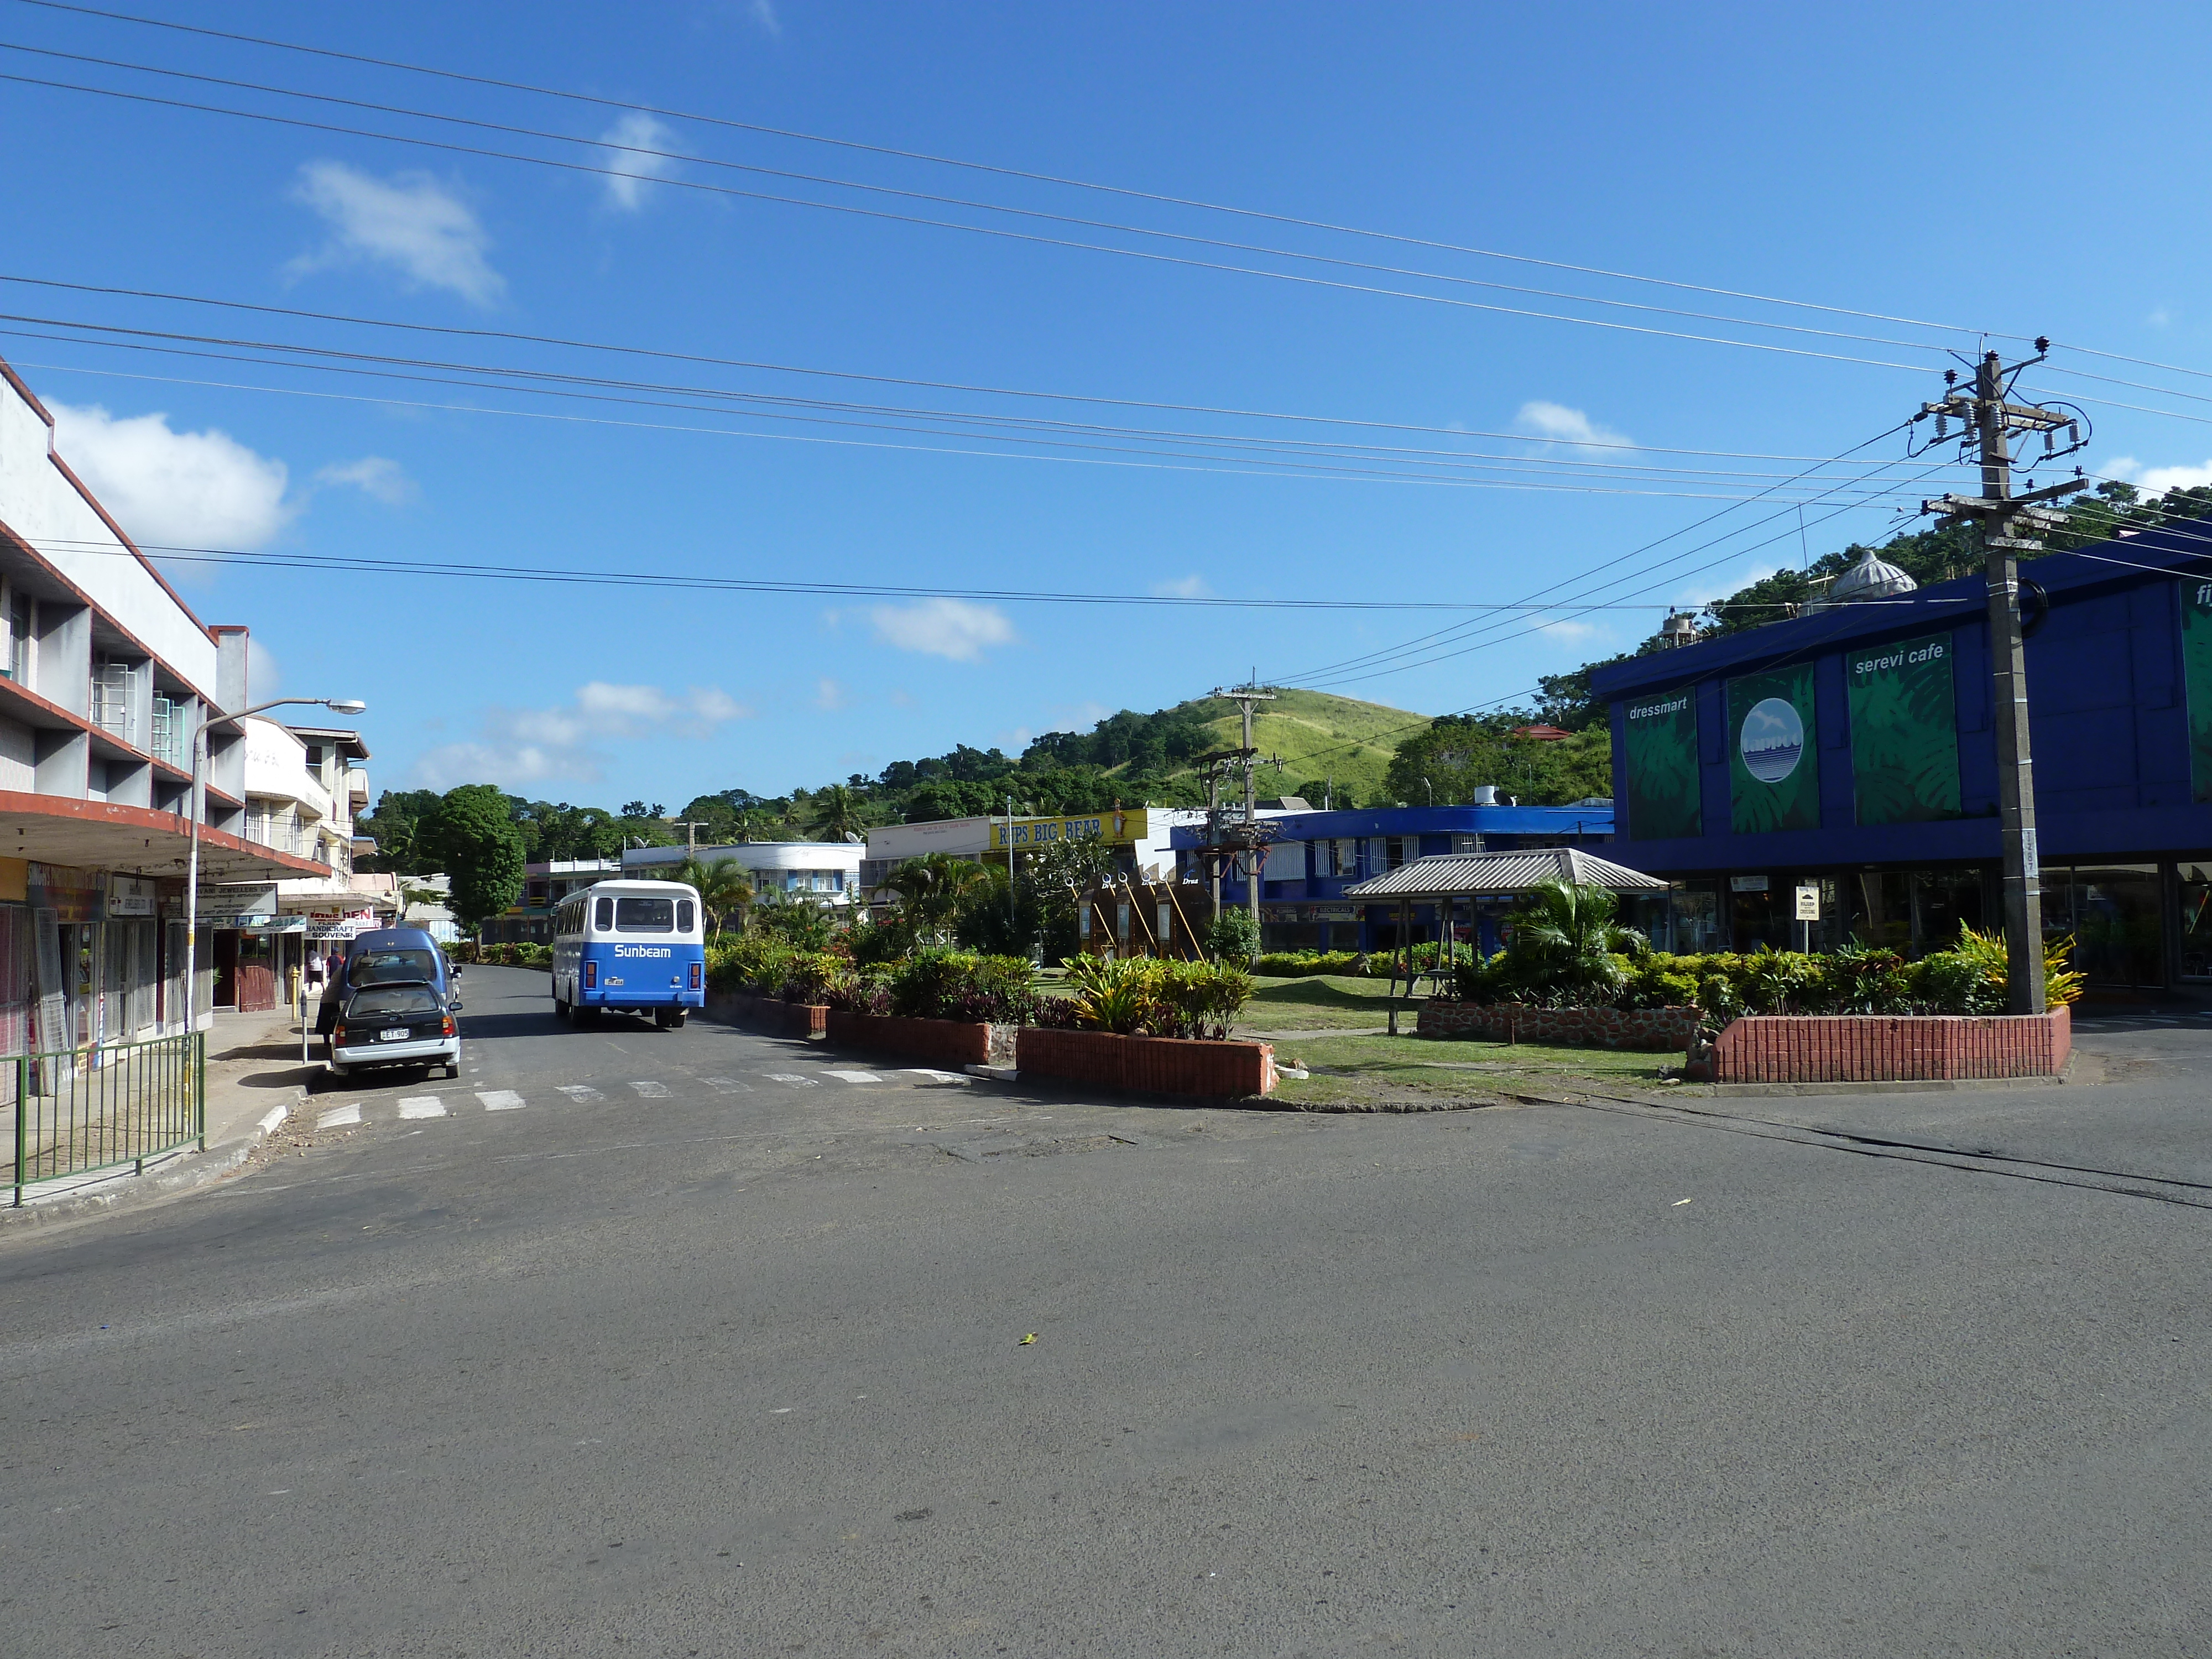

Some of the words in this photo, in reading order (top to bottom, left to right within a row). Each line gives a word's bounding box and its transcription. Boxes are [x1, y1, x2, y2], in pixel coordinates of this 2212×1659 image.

[1855, 650, 1904, 674] serevi
[1908, 643, 1943, 663] cafe
[1630, 696, 1687, 719] dressmart
[1034, 822, 1058, 842] BIG
[1065, 818, 1102, 839] BEAR
[614, 945, 671, 958] Sunbeam
